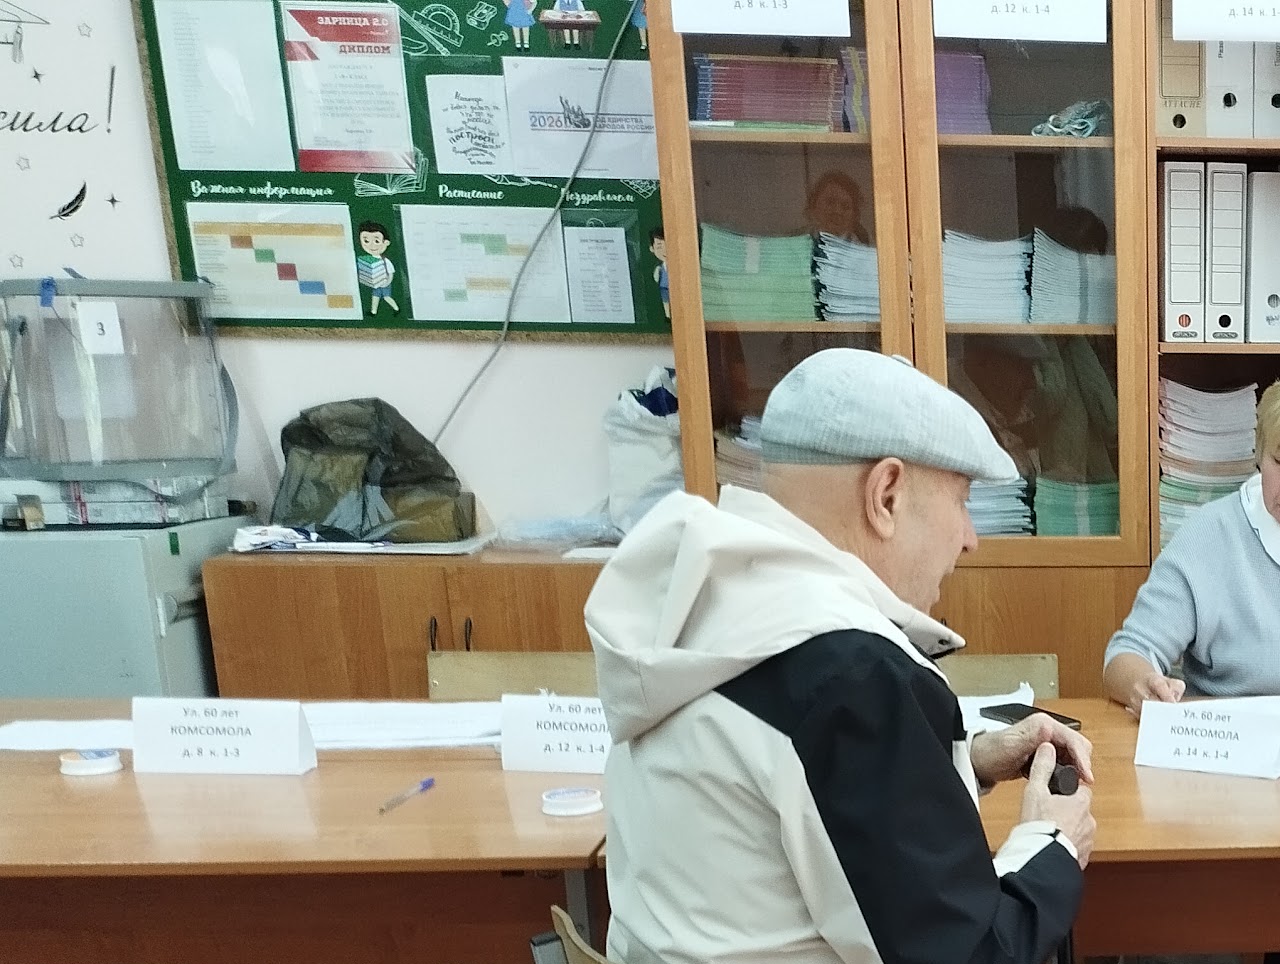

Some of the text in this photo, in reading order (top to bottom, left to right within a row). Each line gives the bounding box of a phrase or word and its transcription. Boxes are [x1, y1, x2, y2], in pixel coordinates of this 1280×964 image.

[747, 0, 754, 8] 8
[772, 0, 788, 9] 1-3
[1005, 3, 1016, 14] 12
[1035, 4, 1050, 15] 1-4
[1242, 7, 1254, 17] 14
[317, 16, 371, 27] ЗАРНИЦА
[339, 44, 392, 55] ДИПЛОМ
[529, 115, 563, 129] 2026
[190, 179, 335, 199] Важная информация
[438, 184, 505, 200] Расписание
[96, 321, 106, 336] 3
[183, 707, 240, 718] Ул. 60 лет
[548, 703, 602, 714] Ул. 60 лет
[1183, 708, 1232, 723] Ул. 60 лет
[170, 725, 252, 737] КОМСОМОЛА
[536, 720, 609, 733] КОМСОМОЛ
[1170, 725, 1240, 741] КОМСОМОЛА
[196, 747, 204, 757] 8
[224, 747, 240, 758] 1-3
[544, 743, 554, 753] д.
[558, 742, 570, 752] 12
[590, 744, 605, 753] 1-4
[1187, 747, 1198, 756] 14
[1214, 750, 1229, 760] 1-4
